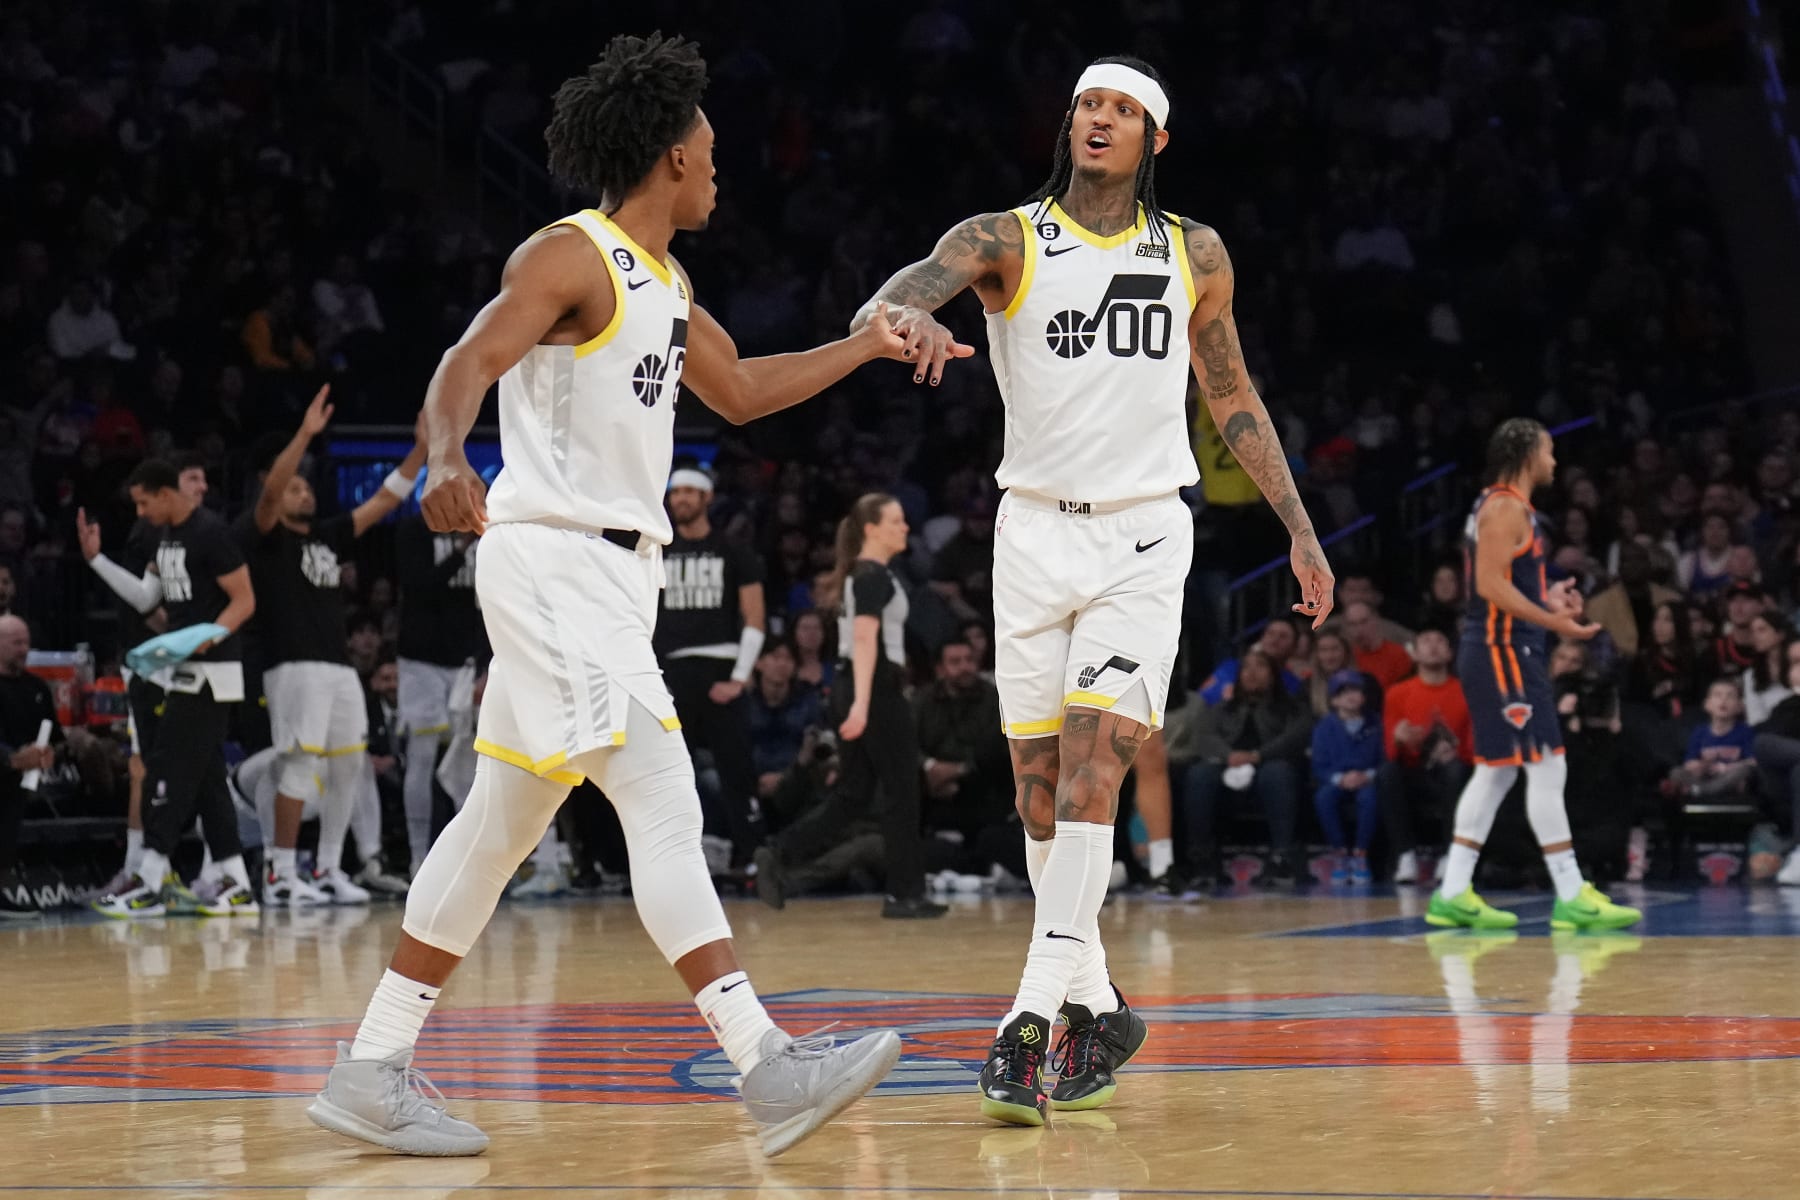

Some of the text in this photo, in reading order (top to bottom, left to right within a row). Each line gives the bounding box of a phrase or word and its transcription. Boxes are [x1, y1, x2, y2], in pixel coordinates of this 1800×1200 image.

[1041, 224, 1057, 239] 6
[1137, 244, 1147, 256] 5
[614, 250, 633, 270] 6
[1107, 302, 1172, 360] 00
